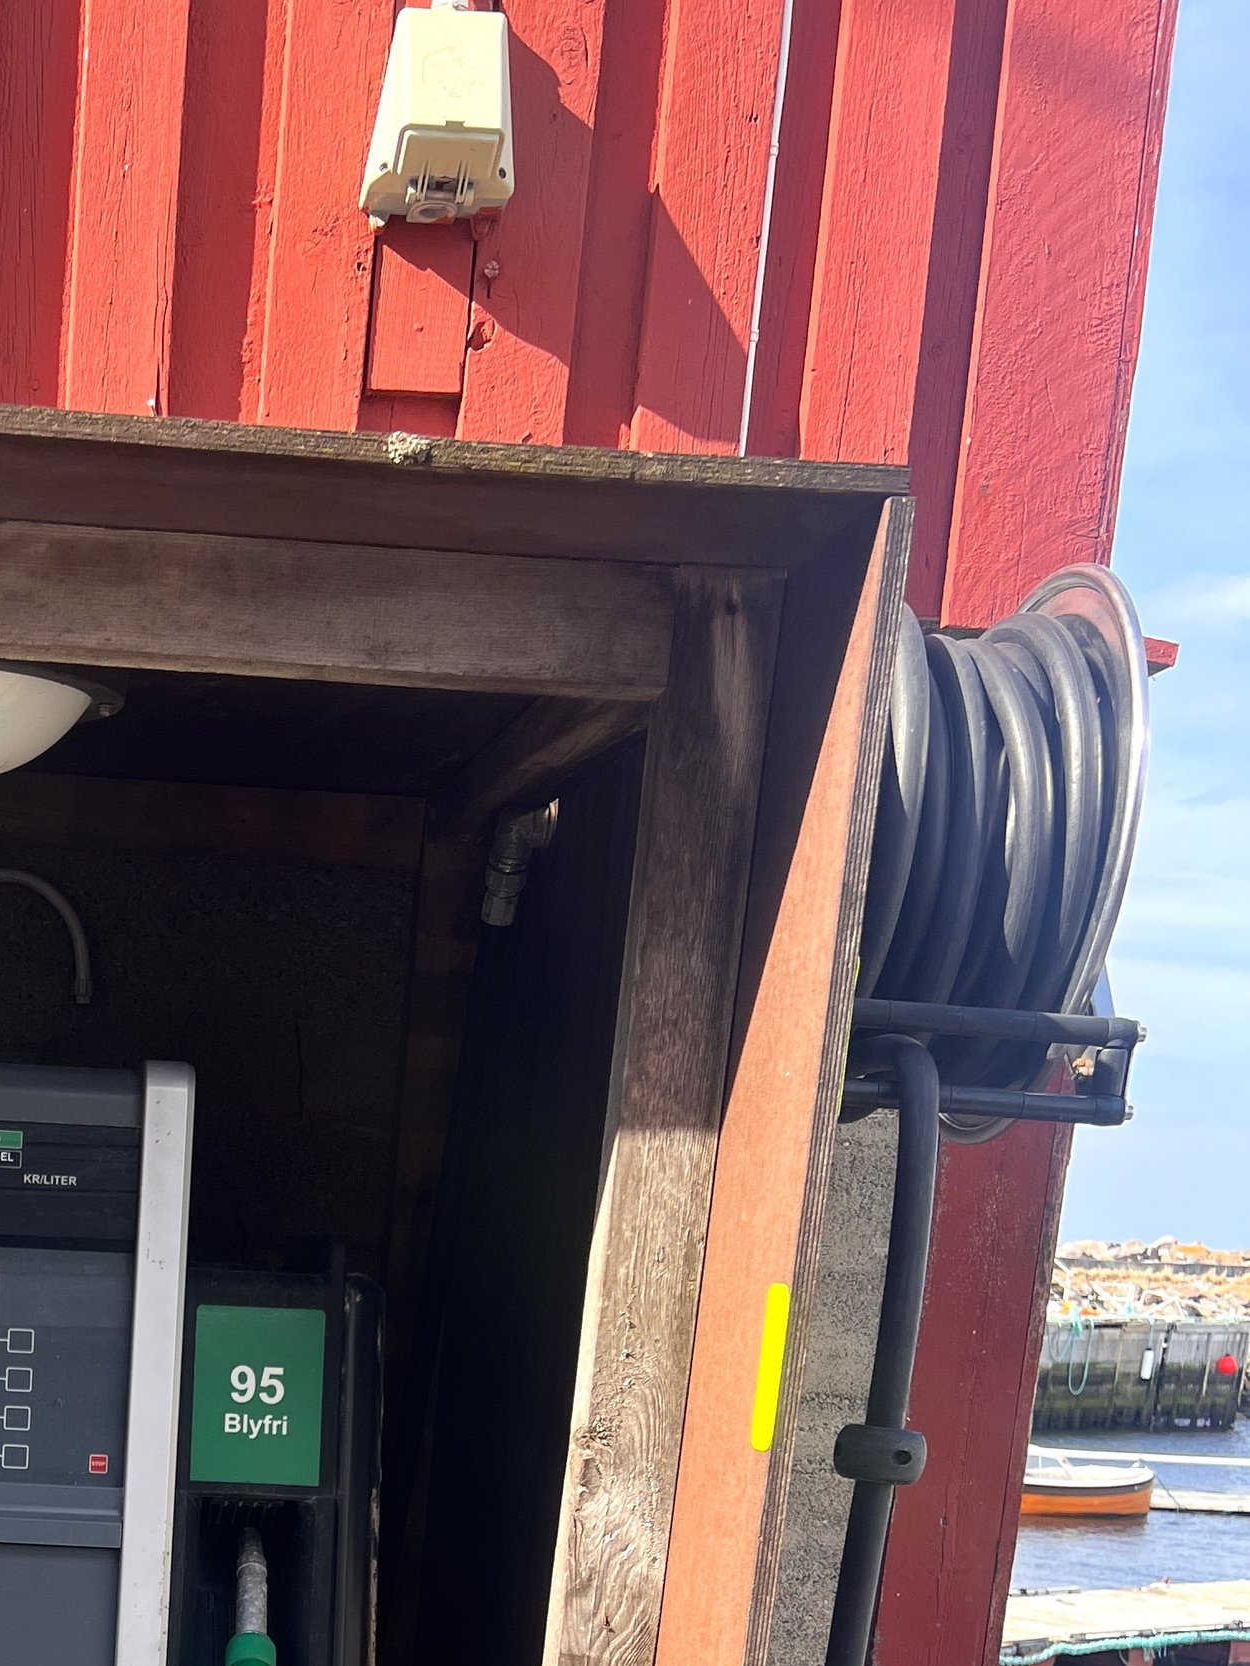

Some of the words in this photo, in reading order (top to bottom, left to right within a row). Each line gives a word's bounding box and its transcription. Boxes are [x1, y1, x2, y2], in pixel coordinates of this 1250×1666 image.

[23, 1173, 77, 1186] KR/LITER
[230, 1364, 285, 1404] 95
[224, 1413, 288, 1439] Blyfri
